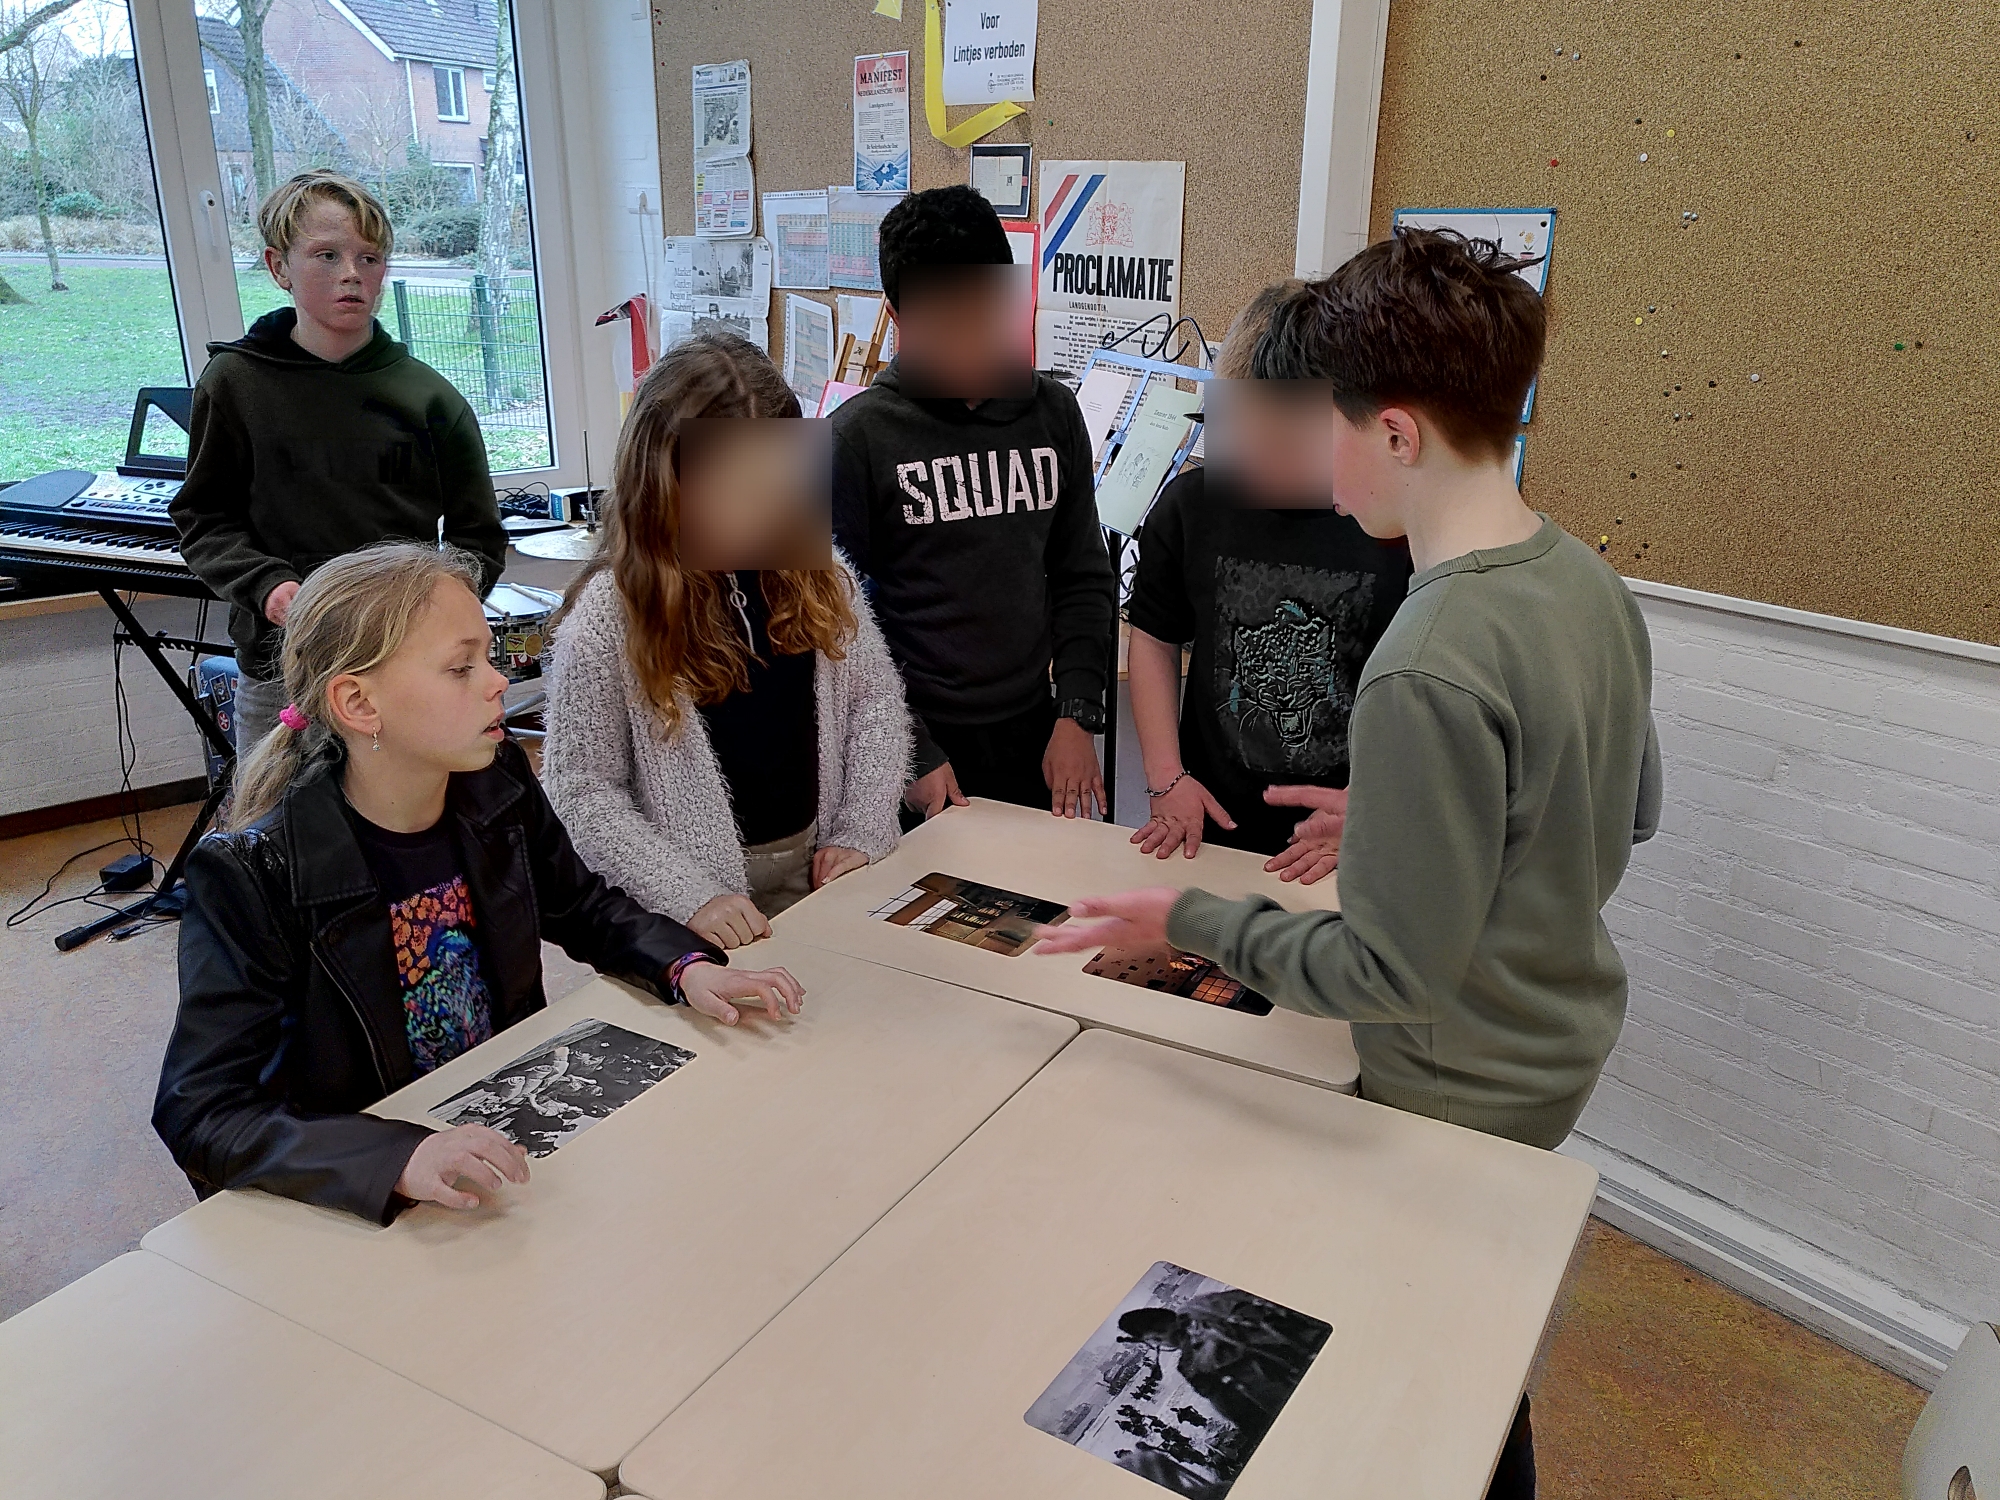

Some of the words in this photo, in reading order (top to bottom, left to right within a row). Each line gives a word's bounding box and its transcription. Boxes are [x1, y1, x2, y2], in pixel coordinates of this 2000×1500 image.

[980, 12, 1000, 30] Voor
[953, 44, 982, 66] Lintjes
[984, 40, 1025, 60] verboden
[860, 69, 902, 84] MANIFEST
[1053, 252, 1174, 302] PROCLAMATIE
[896, 447, 1059, 525] SQUAD
